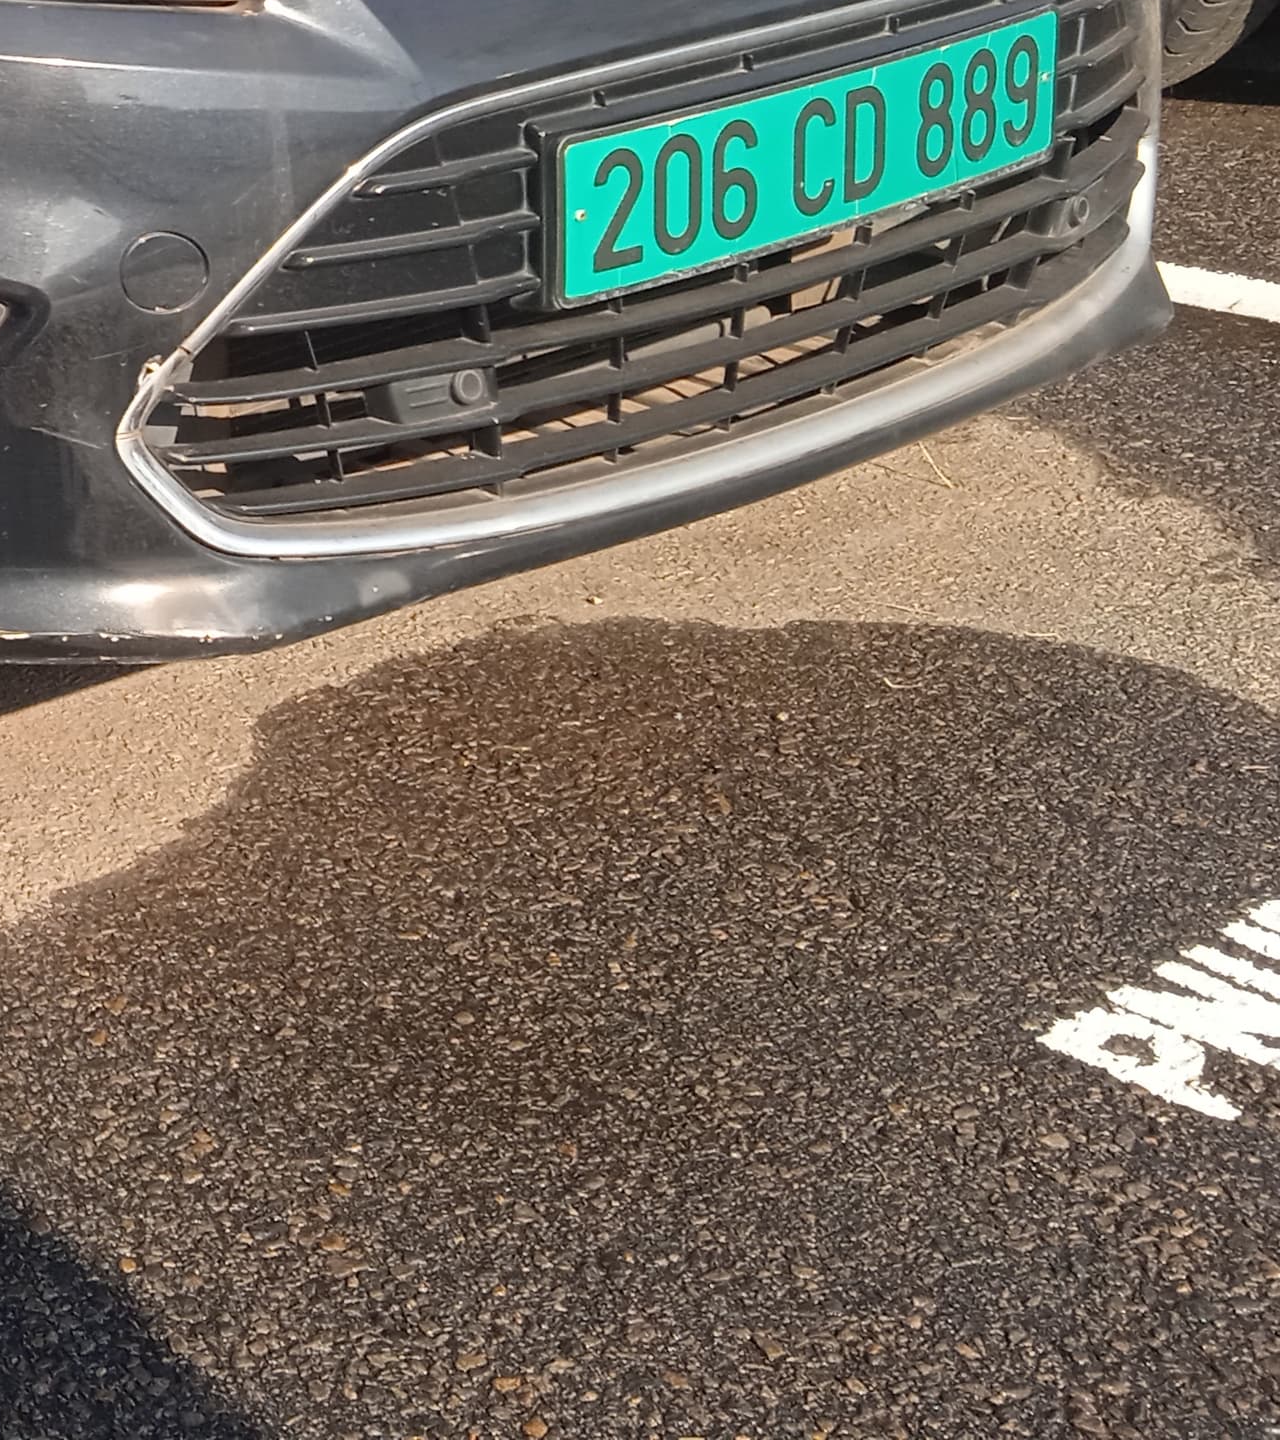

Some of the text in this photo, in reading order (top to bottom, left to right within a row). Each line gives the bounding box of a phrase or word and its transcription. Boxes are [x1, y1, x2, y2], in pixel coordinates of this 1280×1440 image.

[592, 34, 1041, 273] 206 CD 889
